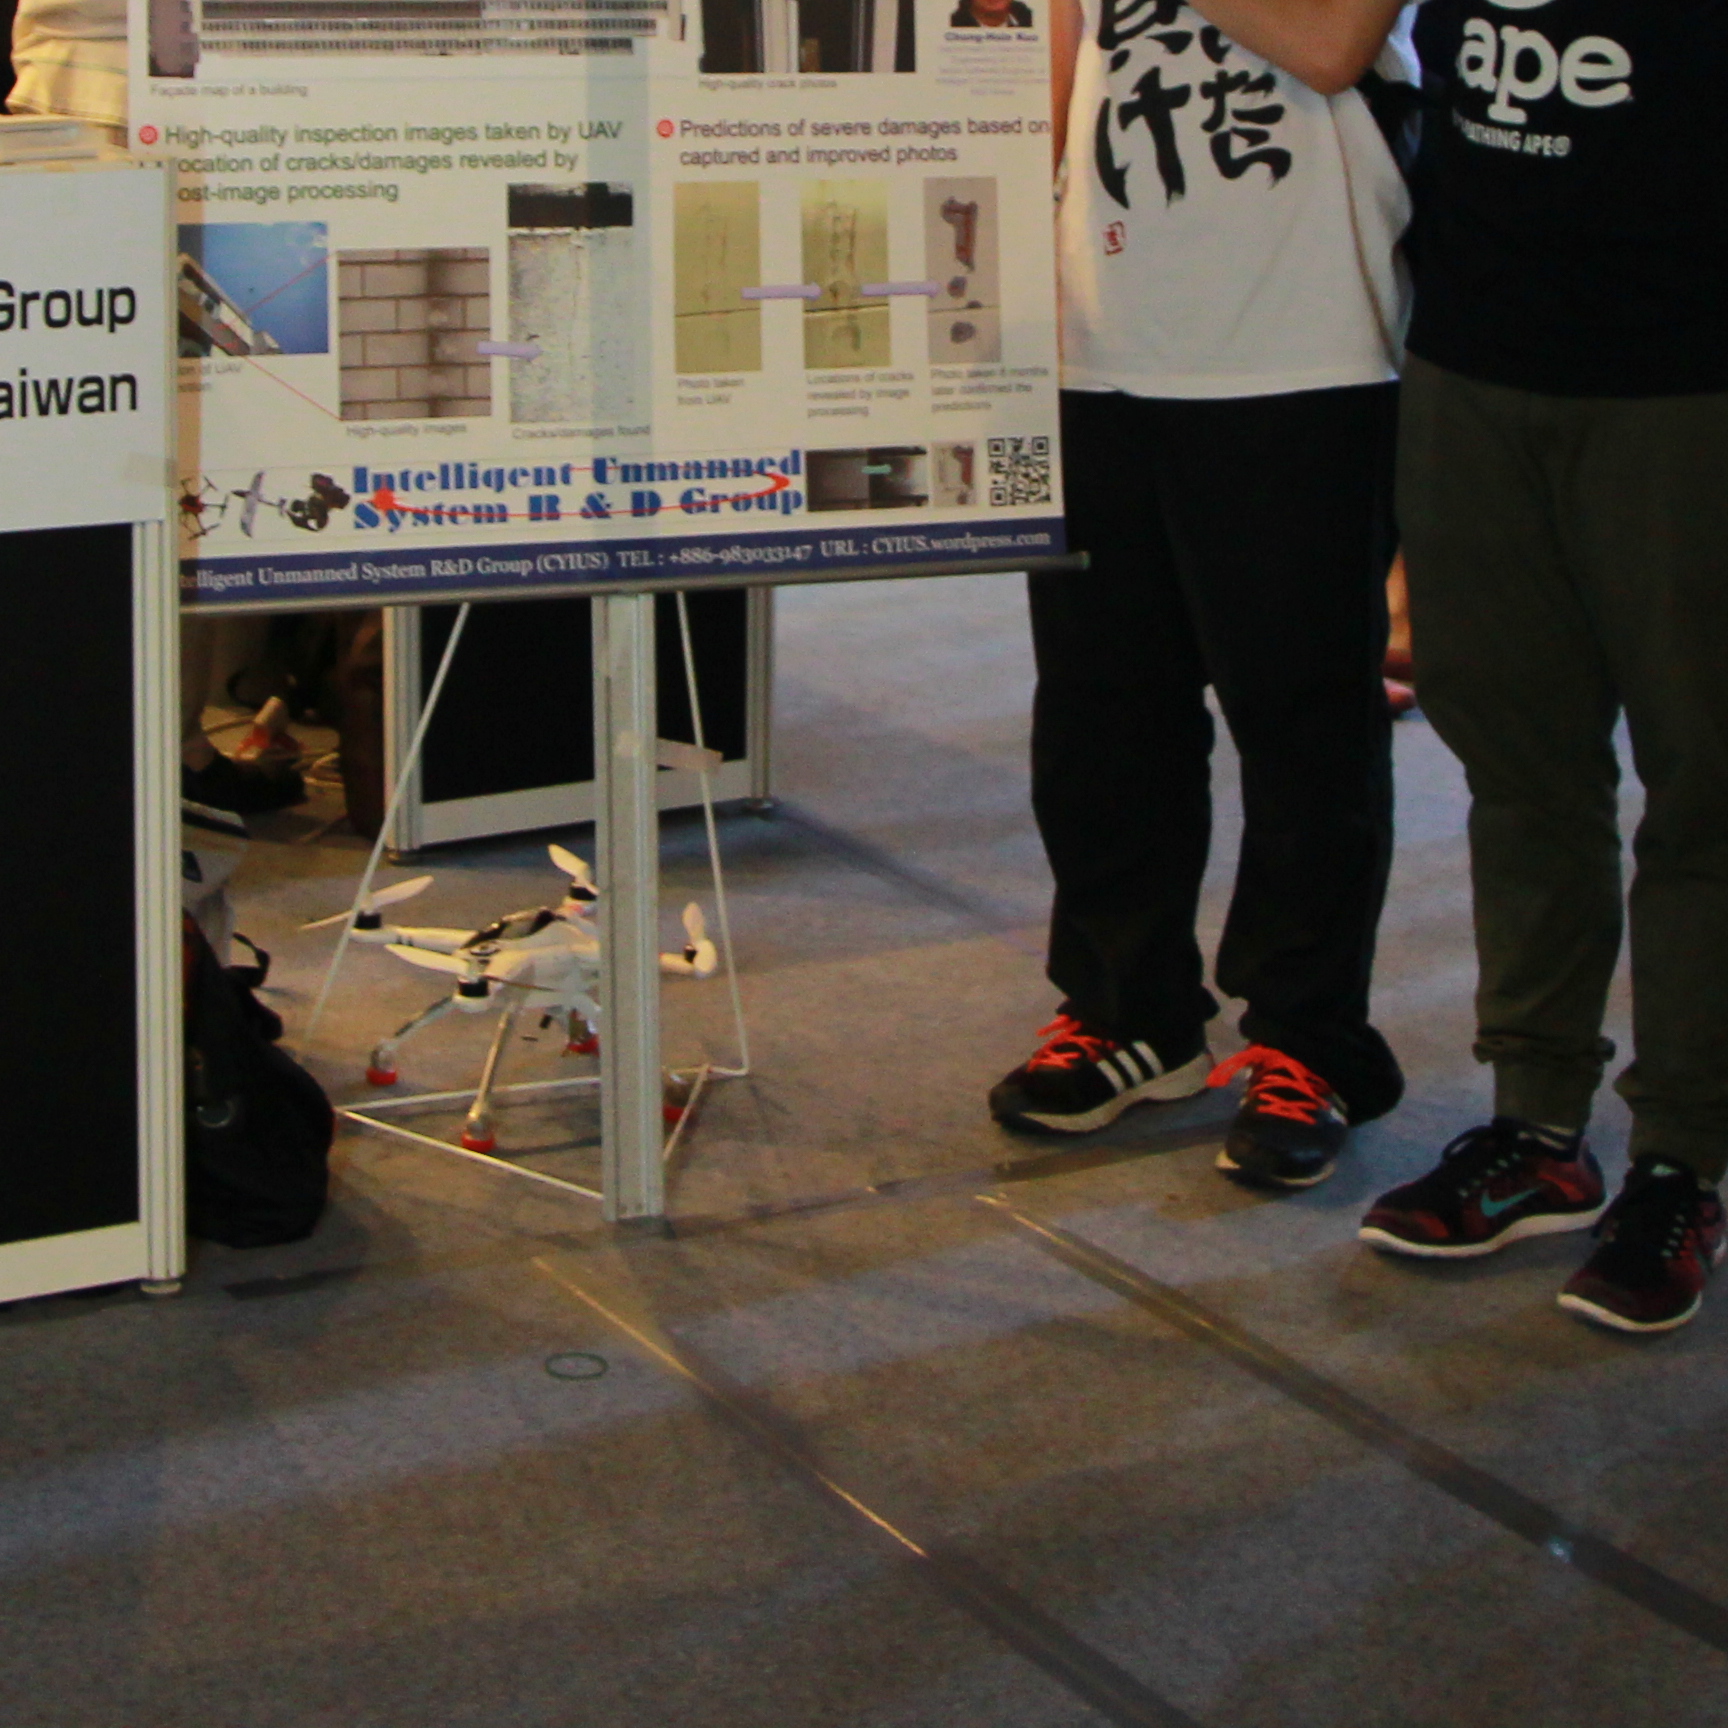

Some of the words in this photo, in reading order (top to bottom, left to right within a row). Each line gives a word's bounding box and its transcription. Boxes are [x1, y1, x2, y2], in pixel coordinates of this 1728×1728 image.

[1457, 17, 1632, 124] ape
[165, 127, 288, 148] High-quality
[294, 127, 398, 143] inspection
[404, 127, 478, 144] images
[484, 124, 540, 139] taken
[547, 123, 571, 142] by
[578, 121, 622, 138] UAV
[680, 120, 782, 136] Predictions
[787, 119, 805, 136] of
[810, 122, 872, 135] severe
[877, 121, 962, 137] damages
[967, 119, 1022, 133] based
[1028, 121, 1048, 133] on
[177, 158, 253, 173] ocation
[259, 153, 280, 171] of
[285, 155, 453, 171] cracks/damages
[459, 152, 547, 167] revealed
[553, 151, 578, 170] by
[353, 462, 574, 494] Intelligent
[592, 449, 803, 482] Unmanned
[353, 498, 509, 533] System
[526, 493, 562, 521] R
[580, 492, 613, 519] &
[630, 489, 664, 516] D
[678, 486, 804, 515] Group
[178, 571, 253, 590] telligent
